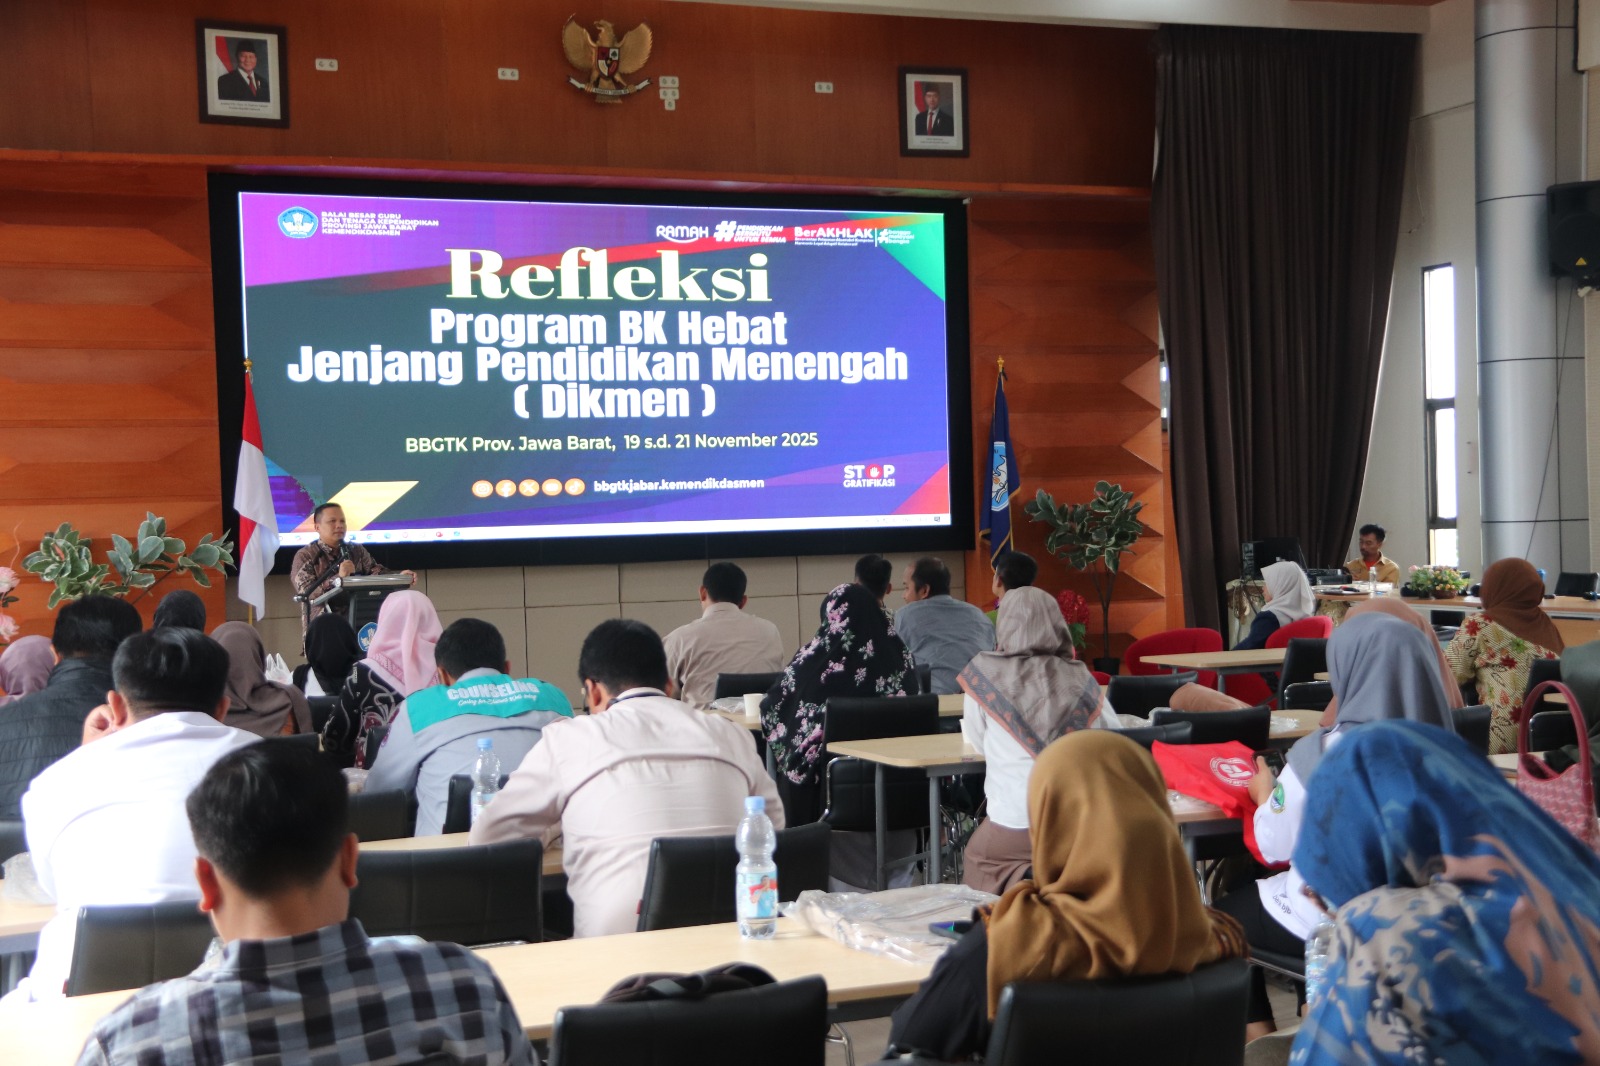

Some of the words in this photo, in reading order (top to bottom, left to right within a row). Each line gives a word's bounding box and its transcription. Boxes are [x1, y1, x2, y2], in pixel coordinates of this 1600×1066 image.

[378, 218, 439, 227] KEPENDIDIKAN
[389, 223, 418, 231] BARAT
[322, 228, 401, 236] KEMENDIKDASMEN
[656, 225, 709, 242] RAMAH
[794, 226, 874, 239] BerAKHLAK
[445, 247, 773, 302] Refleksi
[430, 308, 607, 347] Program
[619, 310, 667, 343] BK
[679, 311, 788, 346] Hebat
[287, 345, 463, 386] Jenjang
[476, 345, 700, 382] Pendidikan
[712, 349, 909, 386] Menengah
[541, 383, 690, 419] Dikmen
[405, 437, 469, 453] BBGTK
[472, 437, 515, 452] Prov.
[518, 436, 562, 451] Jawa
[567, 435, 616, 452] Barat,
[624, 435, 641, 449] 19
[644, 434, 671, 449] s.d.
[675, 434, 691, 448] 21
[695, 433, 777, 448] November
[781, 432, 819, 447] 2025
[593, 476, 765, 494] bbgtkjabar.kemendikdasmen
[843, 477, 896, 489] GRATIFIKASI
[447, 680, 540, 700] COUNSELING
